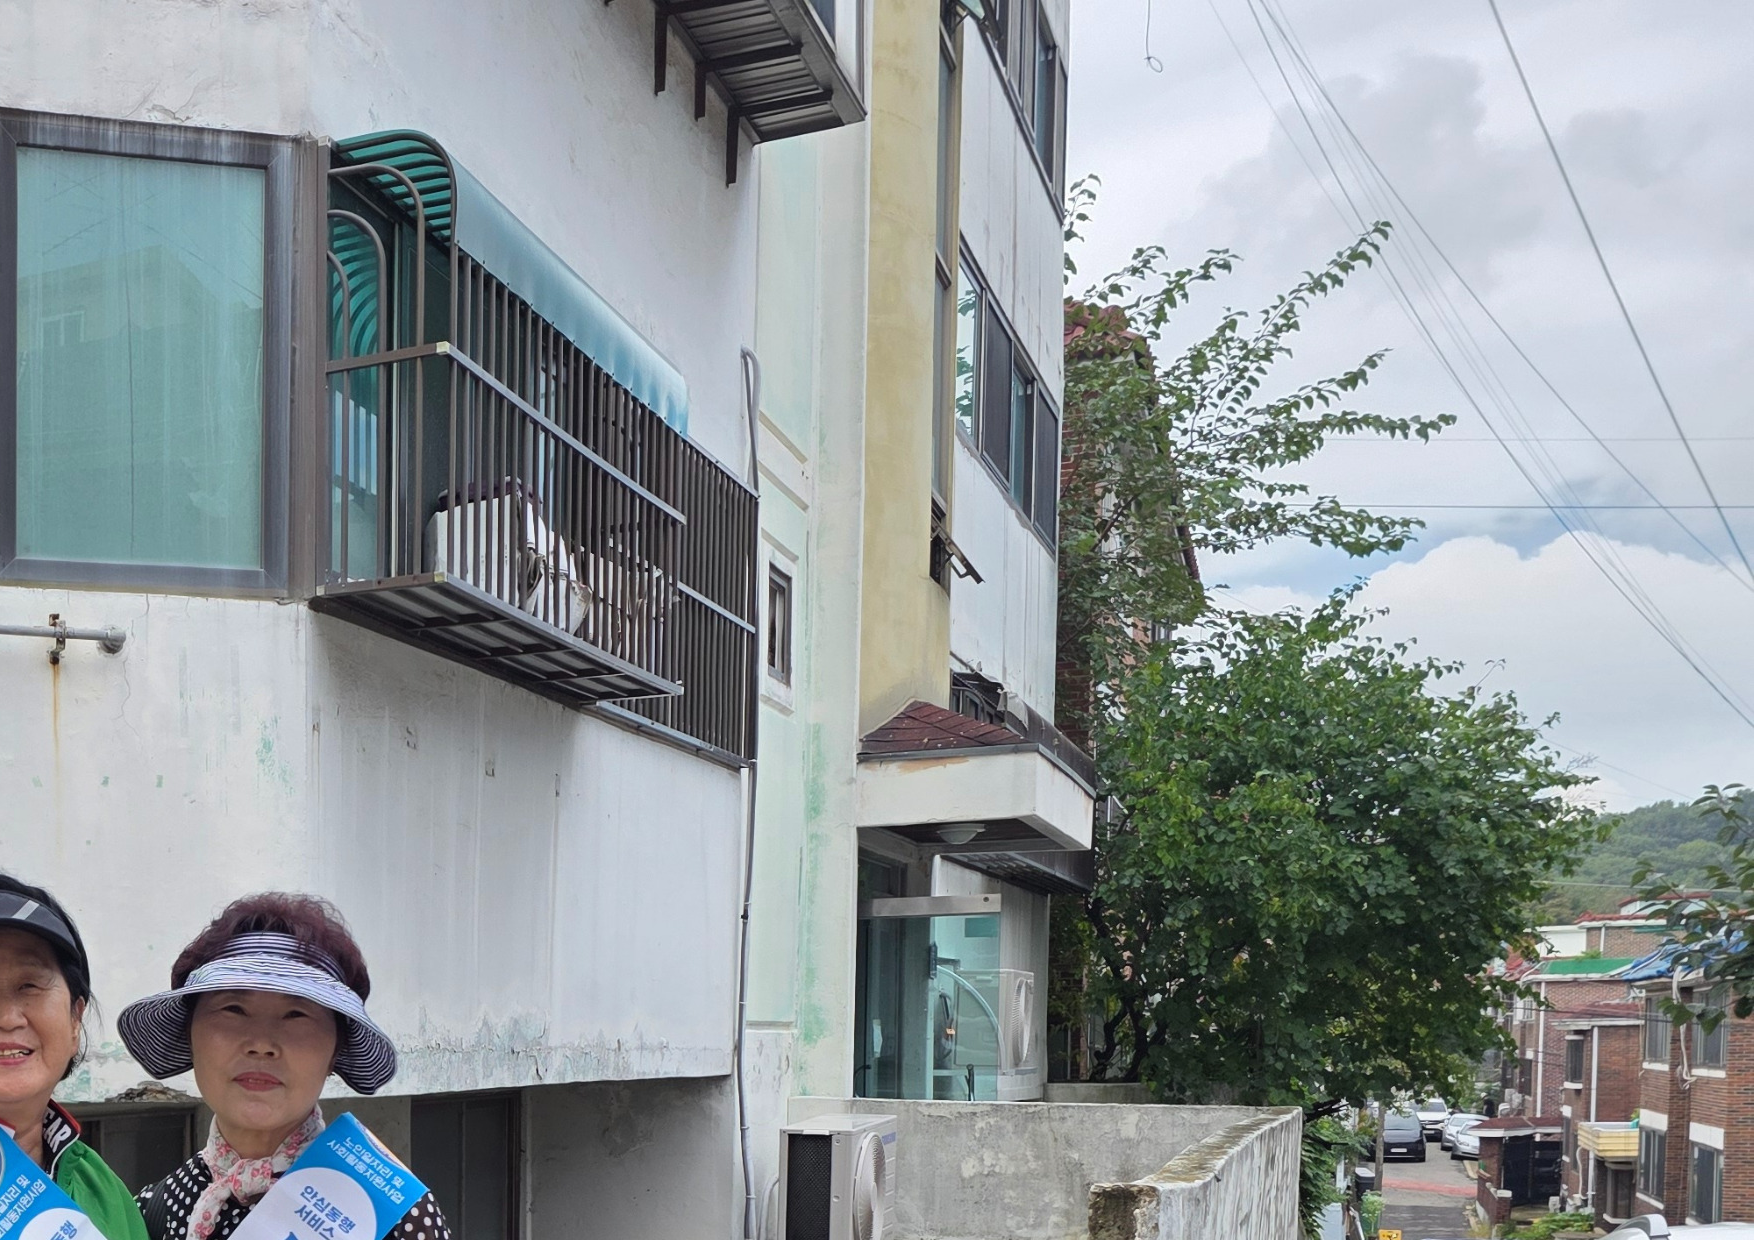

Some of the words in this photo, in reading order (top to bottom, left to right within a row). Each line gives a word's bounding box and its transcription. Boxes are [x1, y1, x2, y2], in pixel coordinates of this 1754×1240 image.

[326, 1139, 405, 1205] 사회활동지원사업
[342, 1136, 394, 1179] 노인일자리
[16, 1174, 31, 1189] 및
[299, 1185, 357, 1234] 안심동행
